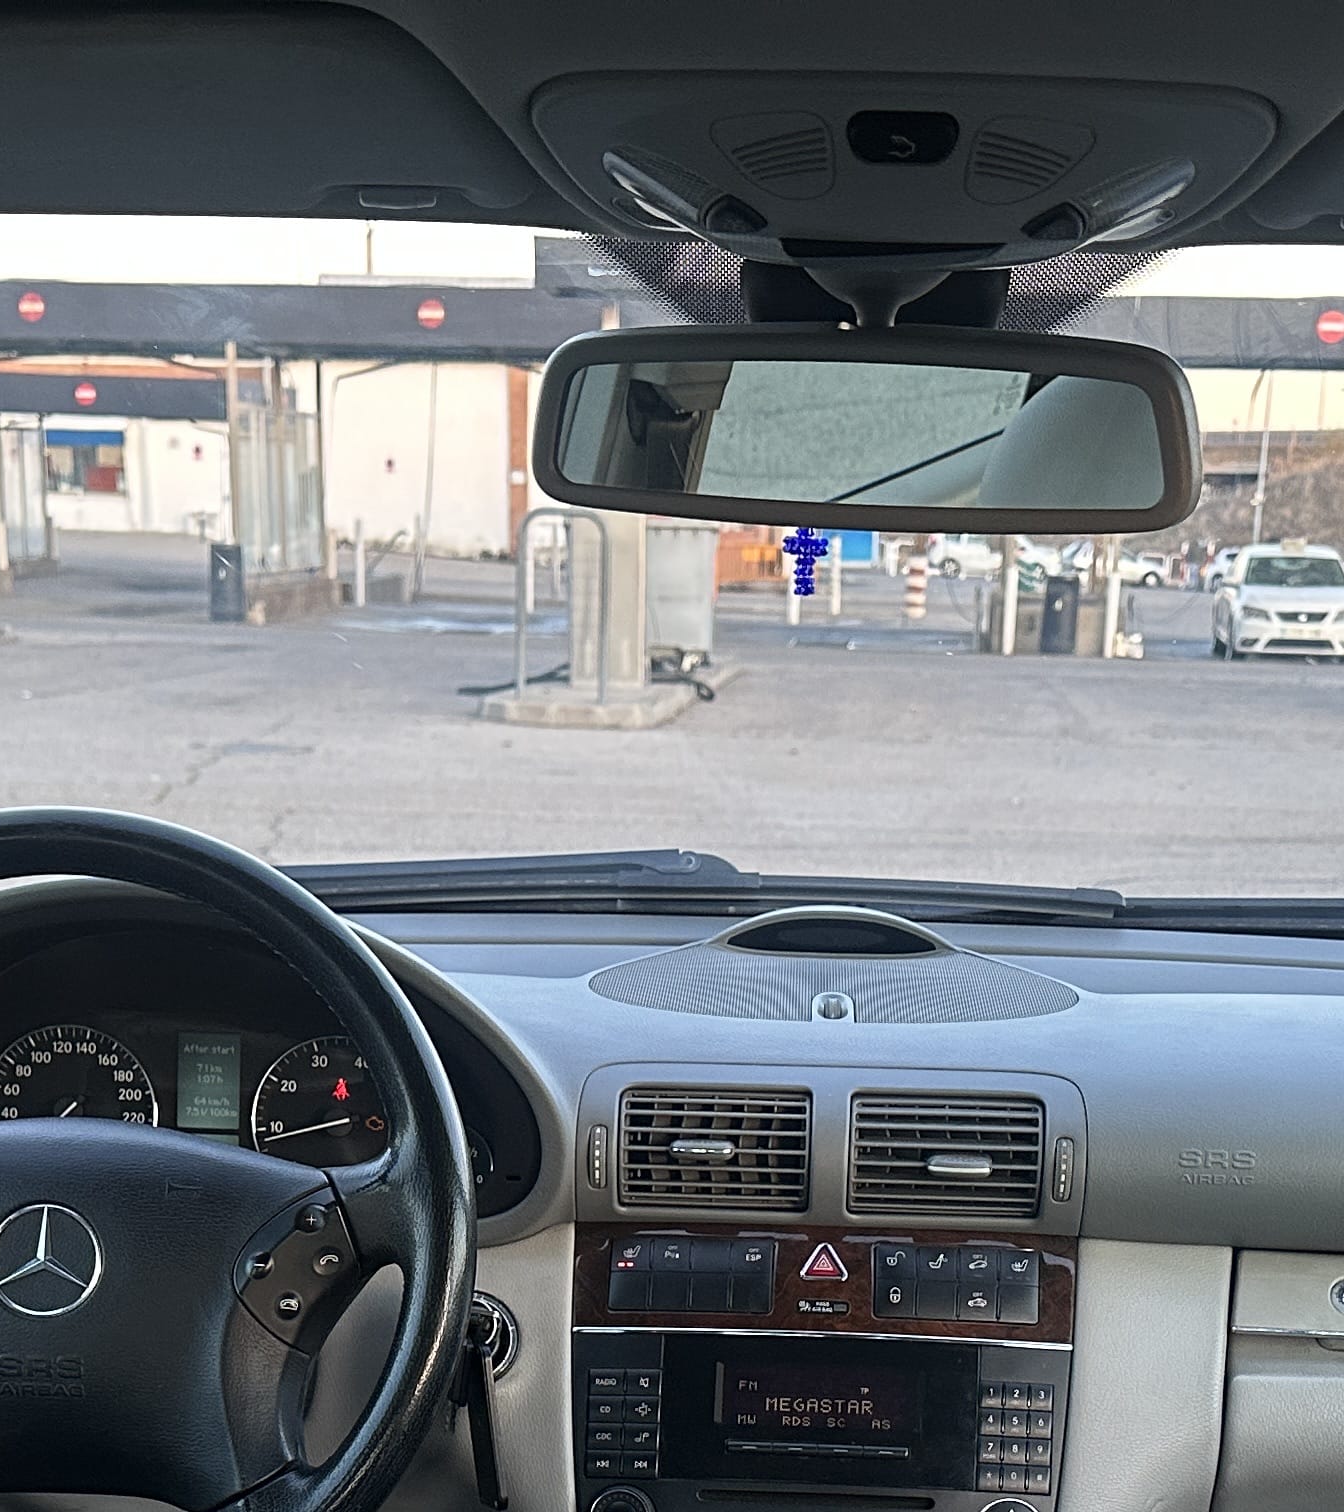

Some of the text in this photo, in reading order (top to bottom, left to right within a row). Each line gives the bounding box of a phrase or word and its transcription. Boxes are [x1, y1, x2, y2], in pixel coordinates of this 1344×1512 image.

[53, 1041, 72, 1054] 120
[76, 1042, 96, 1055] 140
[31, 1051, 51, 1063] 100
[98, 1054, 118, 1066] 160
[311, 1055, 328, 1068] 30
[15, 1065, 31, 1077] 80
[113, 1070, 134, 1082] 180
[3, 1083, 20, 1096] 60
[280, 1080, 297, 1092] 20
[118, 1088, 142, 1101] 200
[1, 1107, 18, 1119] 40
[122, 1111, 145, 1125] 220
[270, 1121, 284, 1133] 10
[1178, 1147, 1257, 1170] SRS
[1182, 1173, 1256, 1186] AIRBAG
[745, 1253, 762, 1262] ESP
[595, 1378, 617, 1386] RADIO
[738, 1379, 870, 1395] FM TP
[1013, 1389, 1020, 1398] 2
[1038, 1390, 1045, 1399] 3
[765, 1397, 873, 1415] MEGASTAR
[737, 1413, 891, 1430] MW RDS SC AS
[987, 1414, 994, 1424] 4
[1012, 1416, 1019, 1425] 5
[1038, 1417, 1045, 1427] 6
[595, 1432, 613, 1441] CDC
[987, 1442, 994, 1452] 7
[1012, 1444, 1019, 1453] 8
[1036, 1445, 1044, 1454] 9
